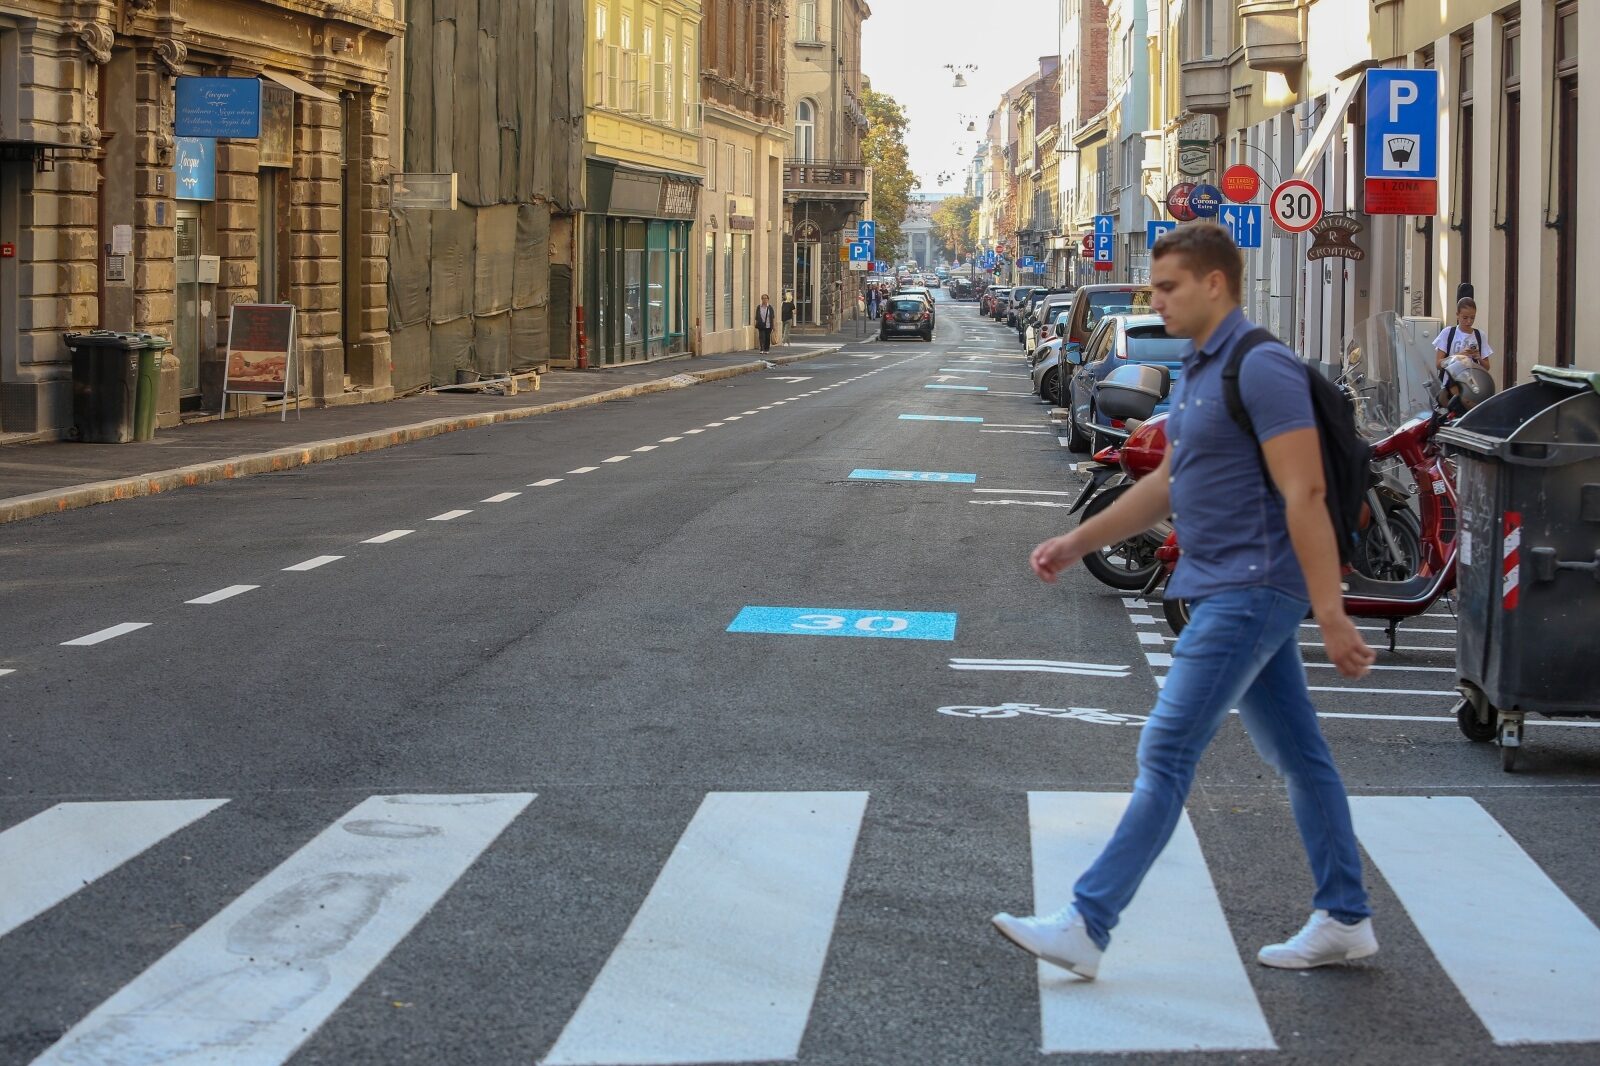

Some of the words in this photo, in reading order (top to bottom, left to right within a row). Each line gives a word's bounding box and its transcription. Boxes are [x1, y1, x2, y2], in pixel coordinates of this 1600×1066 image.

[1389, 79, 1419, 123] P
[1391, 182, 1420, 191] ZONA
[1191, 197, 1218, 205] Corona
[1281, 193, 1311, 220] 30
[1155, 226, 1169, 242] P
[1100, 236, 1108, 248] P
[854, 246, 863, 258] P
[1309, 246, 1362, 260] CROATICA
[1025, 257, 1031, 265] P
[790, 614, 909, 632] 30
